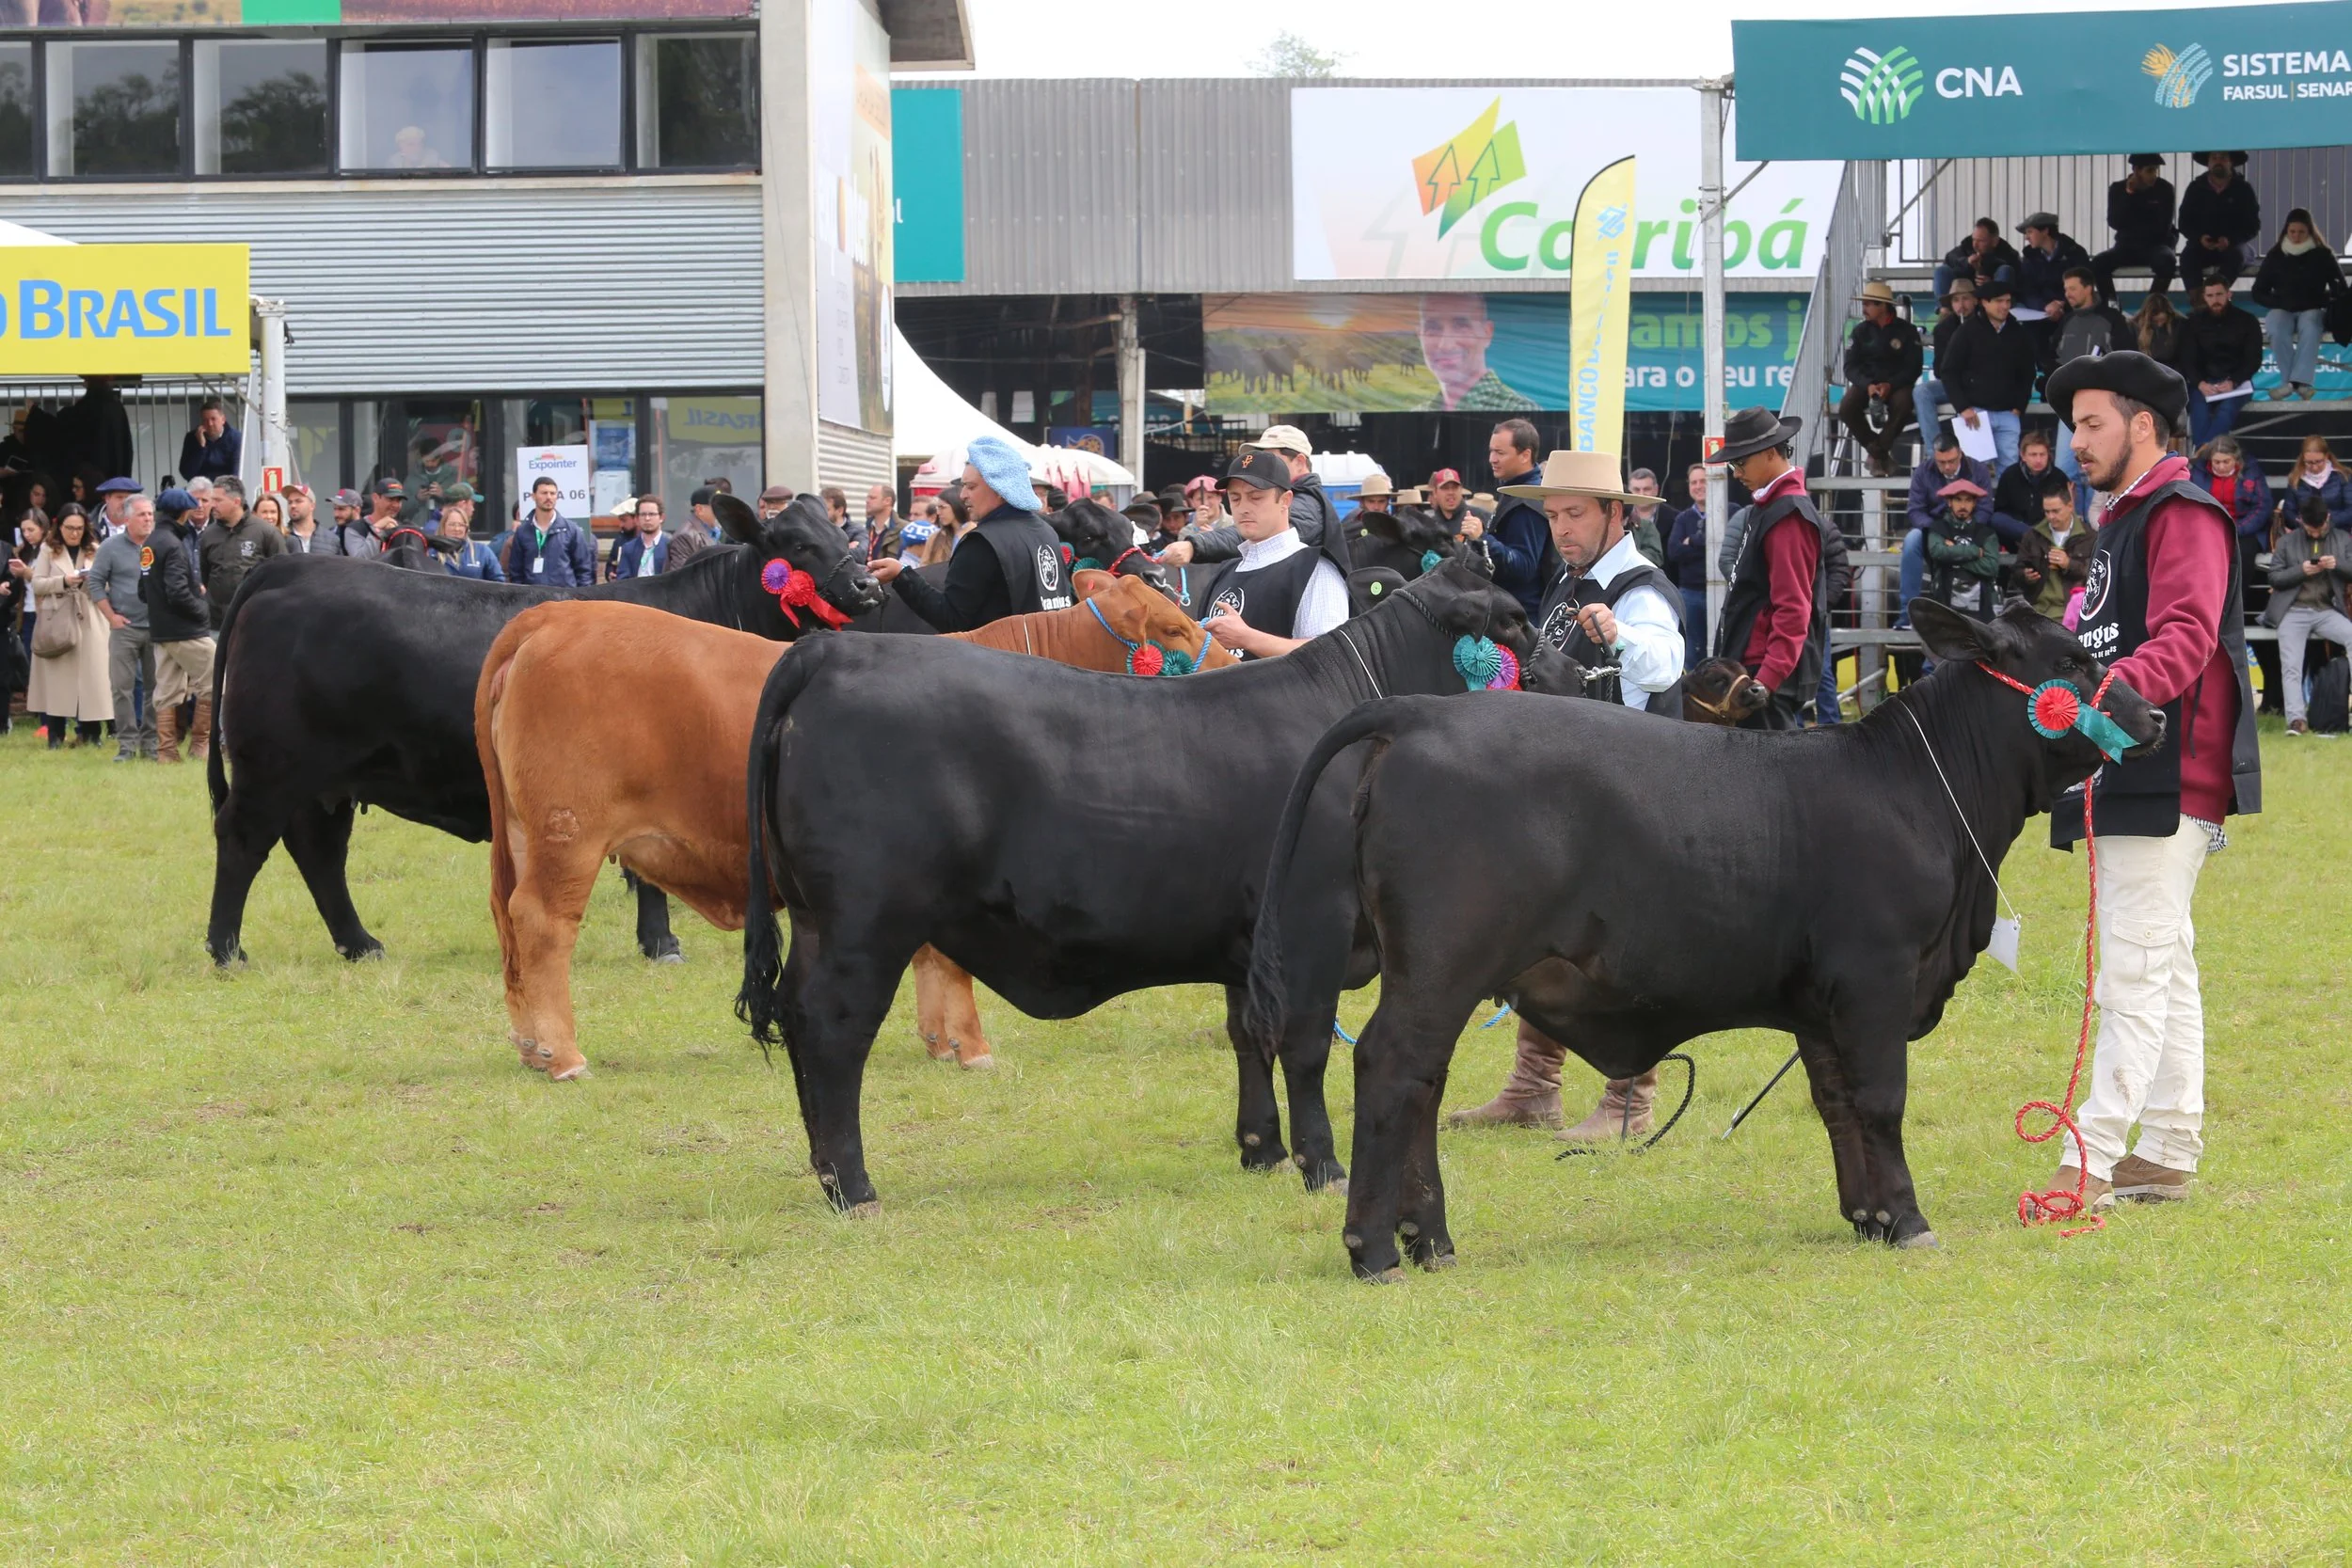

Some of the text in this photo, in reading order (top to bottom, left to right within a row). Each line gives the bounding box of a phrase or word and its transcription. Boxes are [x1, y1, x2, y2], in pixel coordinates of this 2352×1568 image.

[2223, 50, 2351, 77] SISTEMA
[1935, 66, 2024, 99] CNA
[2223, 85, 2288, 101] FARSUL
[1480, 198, 1808, 272] Coribá
[19, 279, 231, 339] BRASIL
[1630, 313, 1772, 348] amos
[1675, 365, 1695, 388] o
[1724, 365, 1756, 388] eu
[529, 460, 578, 471] Expointer
[569, 489, 585, 500] 06
